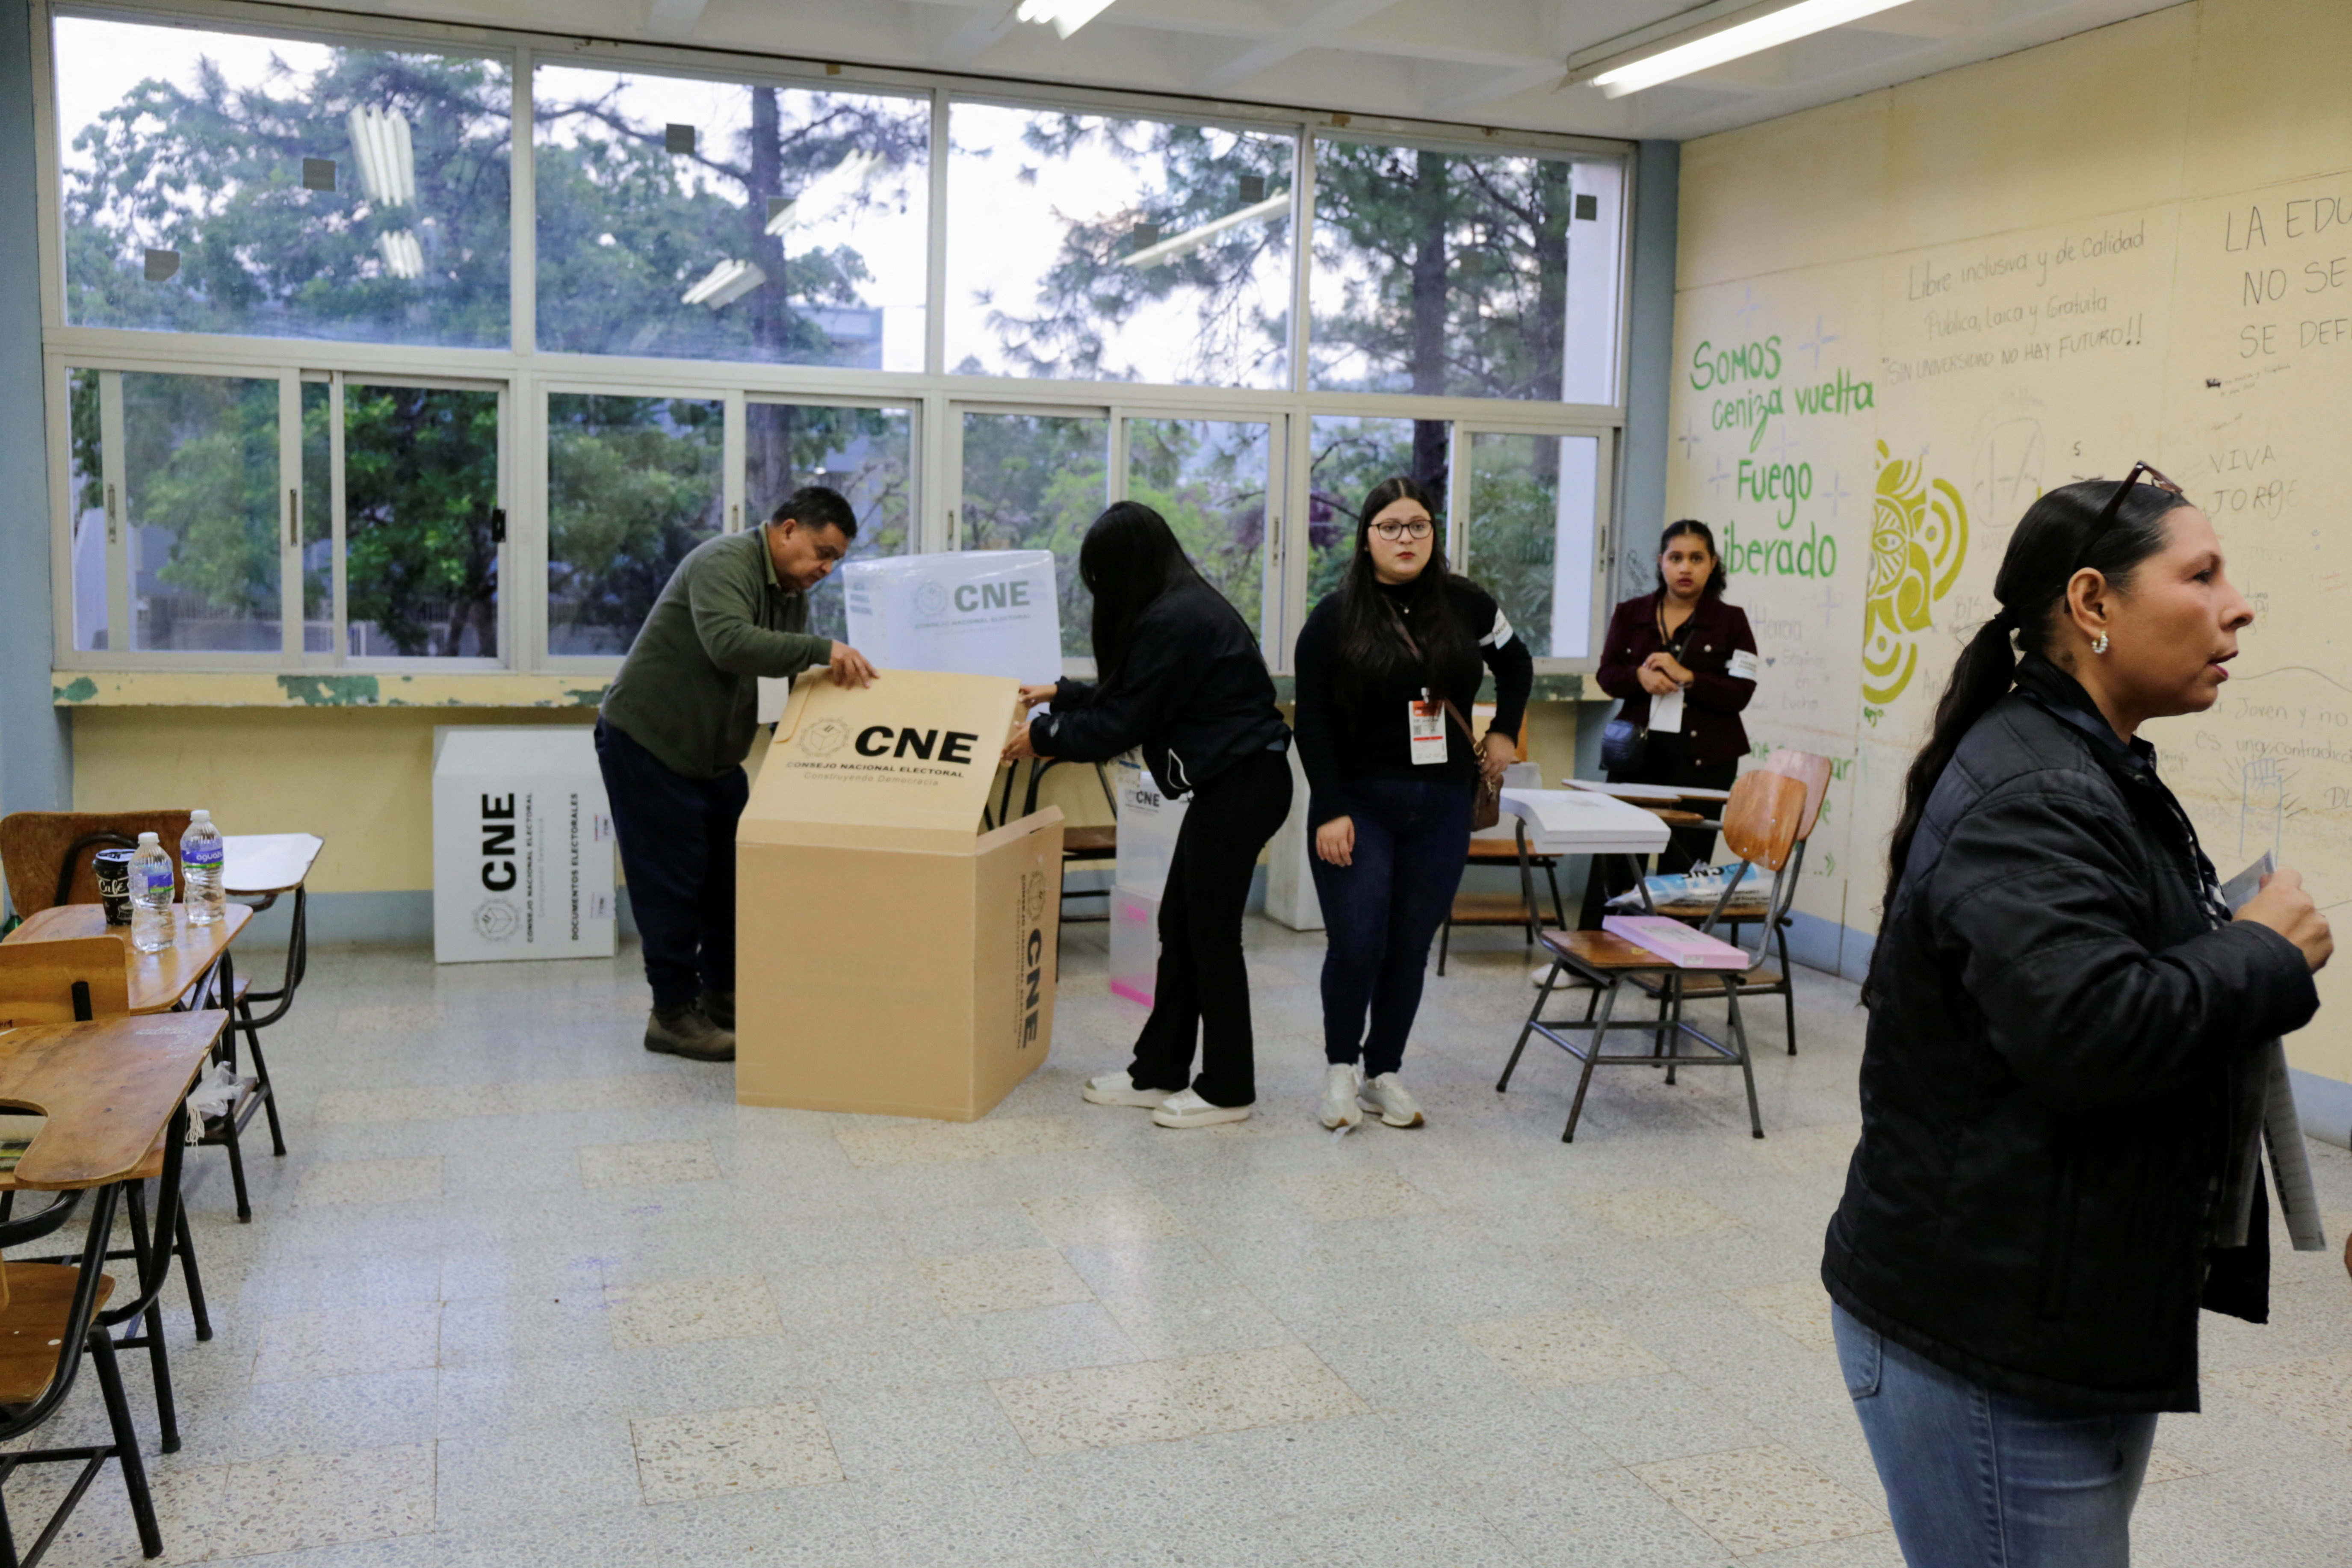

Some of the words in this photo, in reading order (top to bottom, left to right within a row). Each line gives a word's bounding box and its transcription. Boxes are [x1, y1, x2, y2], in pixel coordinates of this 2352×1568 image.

[2226, 206, 2266, 252] LA
[1908, 260, 1951, 301] Libre
[1961, 254, 2028, 284] inclusiva
[2037, 255, 2047, 287] y
[2056, 237, 2075, 265] de
[2082, 219, 2144, 259] Calidad
[2244, 269, 2287, 306] NO
[2305, 257, 2347, 293] SE
[2029, 305, 2038, 336] y
[2046, 287, 2108, 319] Gratuita
[2001, 349, 2018, 365] NO
[2024, 343, 2052, 363] HAY
[2240, 325, 2277, 358] SE
[1795, 367, 1874, 416] vuelta
[2209, 444, 2276, 474] VIVA
[1737, 459, 1813, 531] Fuego
[1720, 520, 1837, 579] iberado
[954, 580, 1031, 612] CNE
[2319, 711, 2349, 727] no
[854, 725, 978, 765] CNE
[786, 761, 837, 770] CONSEJO
[840, 762, 896, 772] NACIONAL
[899, 766, 964, 778] ELECTORAL
[804, 771, 874, 782] Construyendo
[877, 775, 939, 786] Democracia
[525, 792, 533, 847] ELECTORAL
[1136, 790, 1160, 807] CNE
[481, 793, 517, 892] CNE
[570, 792, 579, 866] ELECTORALES
[98, 879, 126, 895] Café
[571, 868, 579, 941] DOCUMENTOS
[1023, 927, 1043, 1049] CNE
